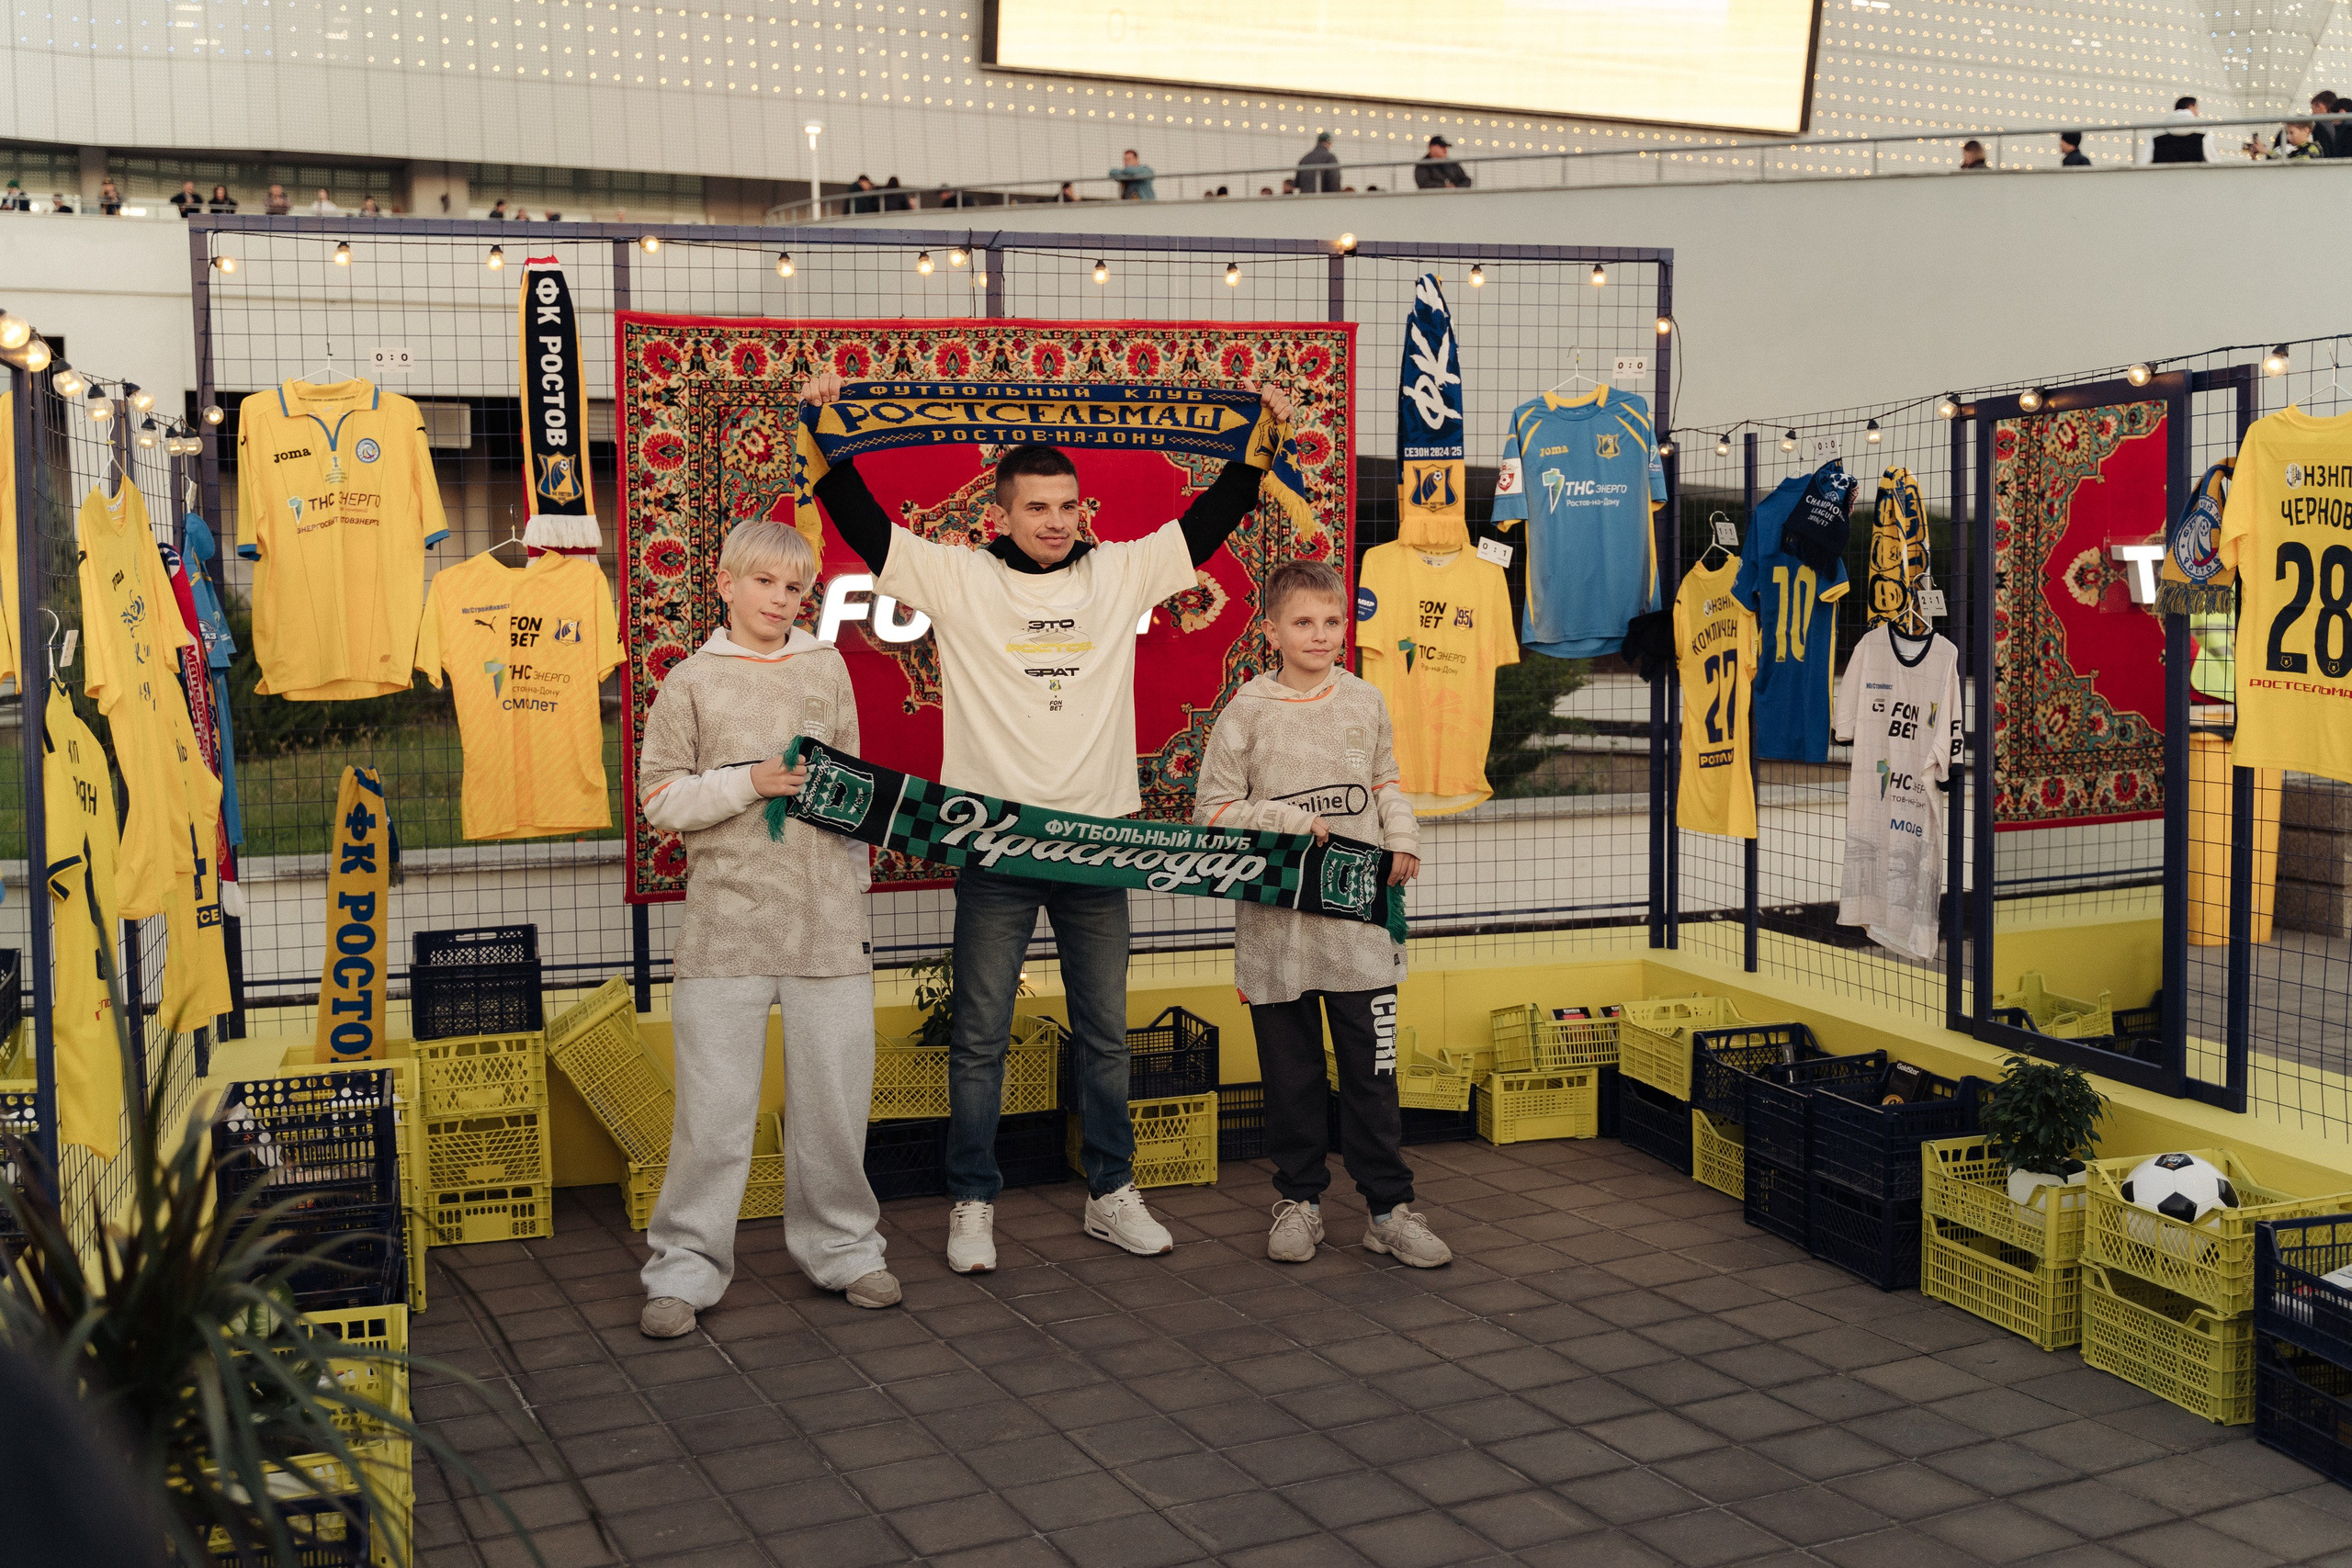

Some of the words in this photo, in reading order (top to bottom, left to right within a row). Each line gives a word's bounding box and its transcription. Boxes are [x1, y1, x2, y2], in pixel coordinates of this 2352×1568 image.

[536, 277, 560, 324] ФК
[538, 335, 568, 446] РОСТОВ
[869, 385, 1091, 398] ФУТБОЛЬНЫЙ
[1125, 389, 1203, 400] КЛУБ
[830, 401, 1226, 433] РОСТСЕЛЬМАШ
[932, 429, 1165, 446] РОСТОВ-НА-ДОНУ
[1404, 446, 1430, 457] СЕЗОН
[1566, 480, 1596, 496] ТНС
[1596, 484, 1628, 494] ЭНЕРГО
[309, 492, 334, 512] ТНС
[339, 491, 381, 508] ЭНЕРГО
[1566, 498, 1620, 507] Ростов-на-Дону
[1811, 507, 1836, 522] LEAGUE
[1457, 608, 1469, 626] 95
[1772, 564, 1816, 662] 10
[2267, 541, 2352, 679] 28
[511, 615, 543, 632] FON
[1028, 619, 1075, 629] ЭТО
[1437, 651, 1466, 663] ЭНЕРГО
[509, 664, 533, 680] НС
[533, 671, 571, 684] ЭНЕРГО
[1024, 668, 1080, 677] БРАТ
[1704, 649, 1737, 743] 27
[1891, 702, 1919, 722] FON
[1888, 720, 1917, 740] BET
[340, 802, 376, 874] ФК
[939, 795, 1266, 893] Краснодар
[1045, 818, 1192, 848] ФУТБОЛЬНЫЙ
[1195, 833, 1251, 852] КЛУБ
[330, 891, 377, 1064] РОСТО
[1896, 1063, 1919, 1076] GoldStar
